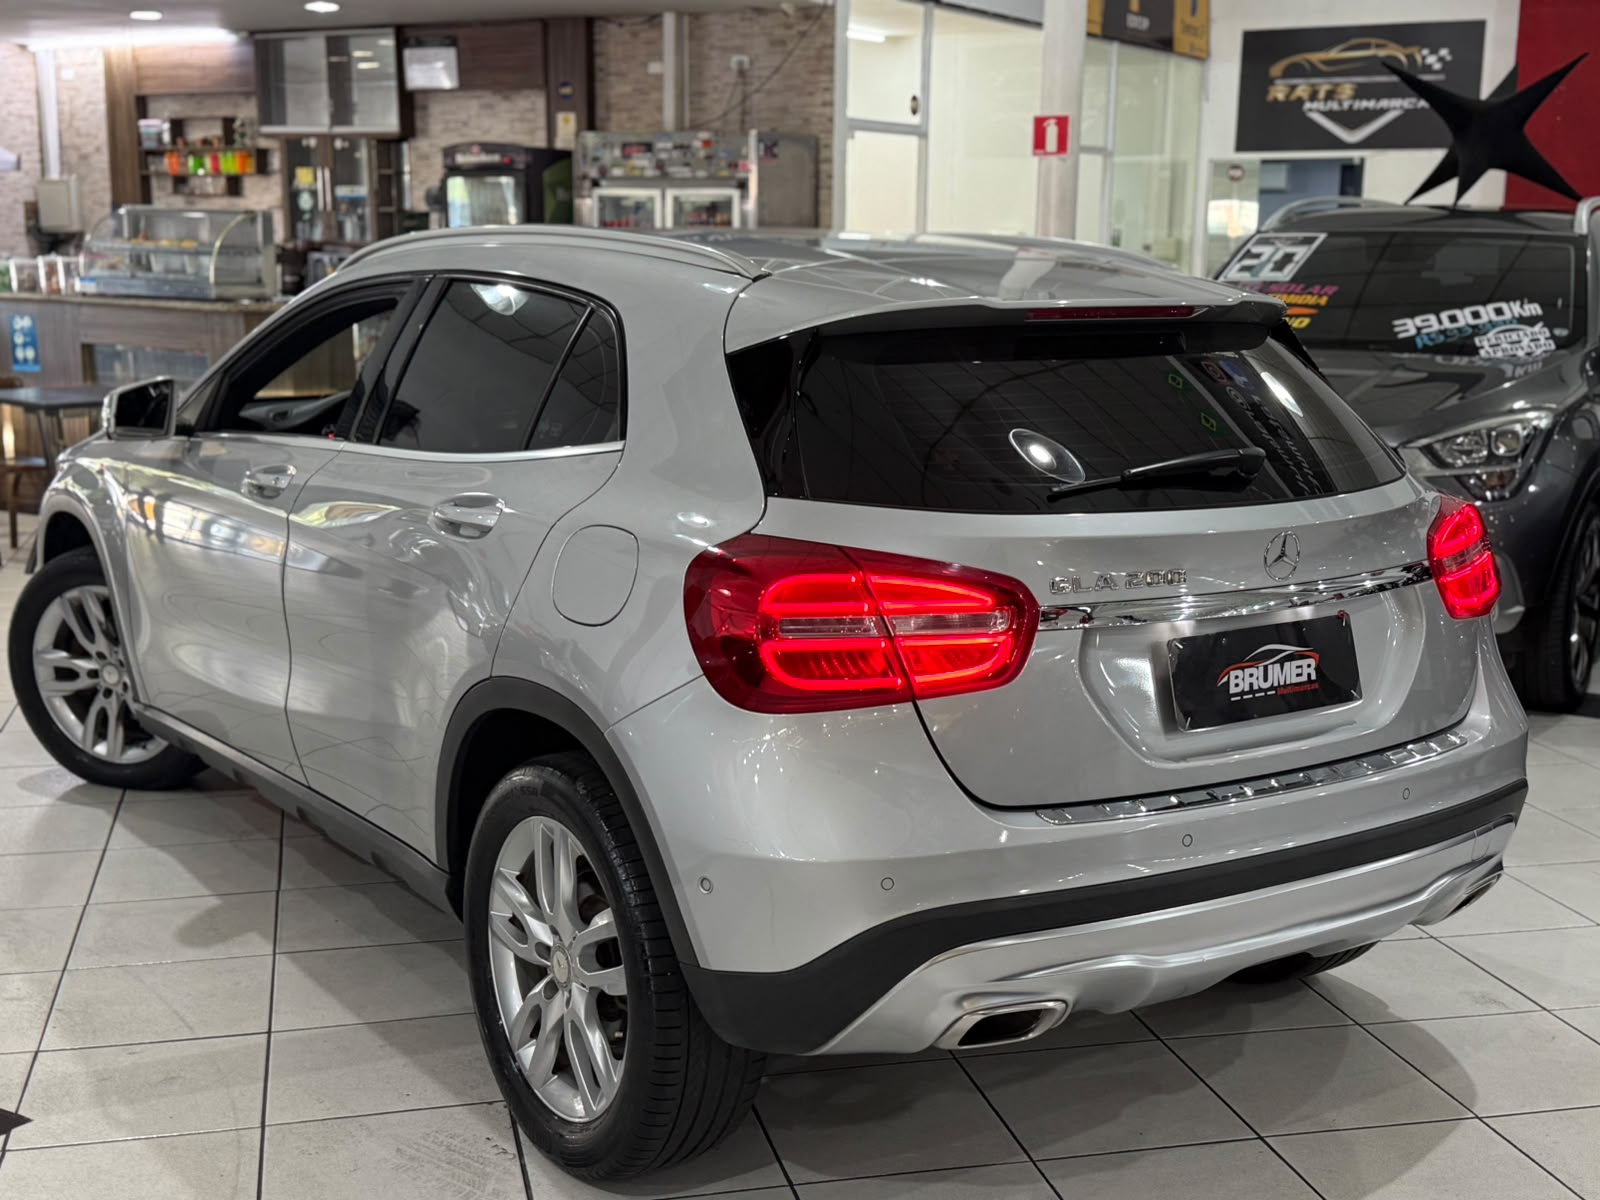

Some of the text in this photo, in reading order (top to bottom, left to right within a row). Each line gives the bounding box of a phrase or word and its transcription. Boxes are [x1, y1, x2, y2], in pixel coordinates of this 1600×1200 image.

[1266, 83, 1358, 102] RATS
[1223, 245, 1312, 281] 20
[1049, 568, 1187, 594] GLA 200
[1229, 658, 1317, 694] BRUMER
